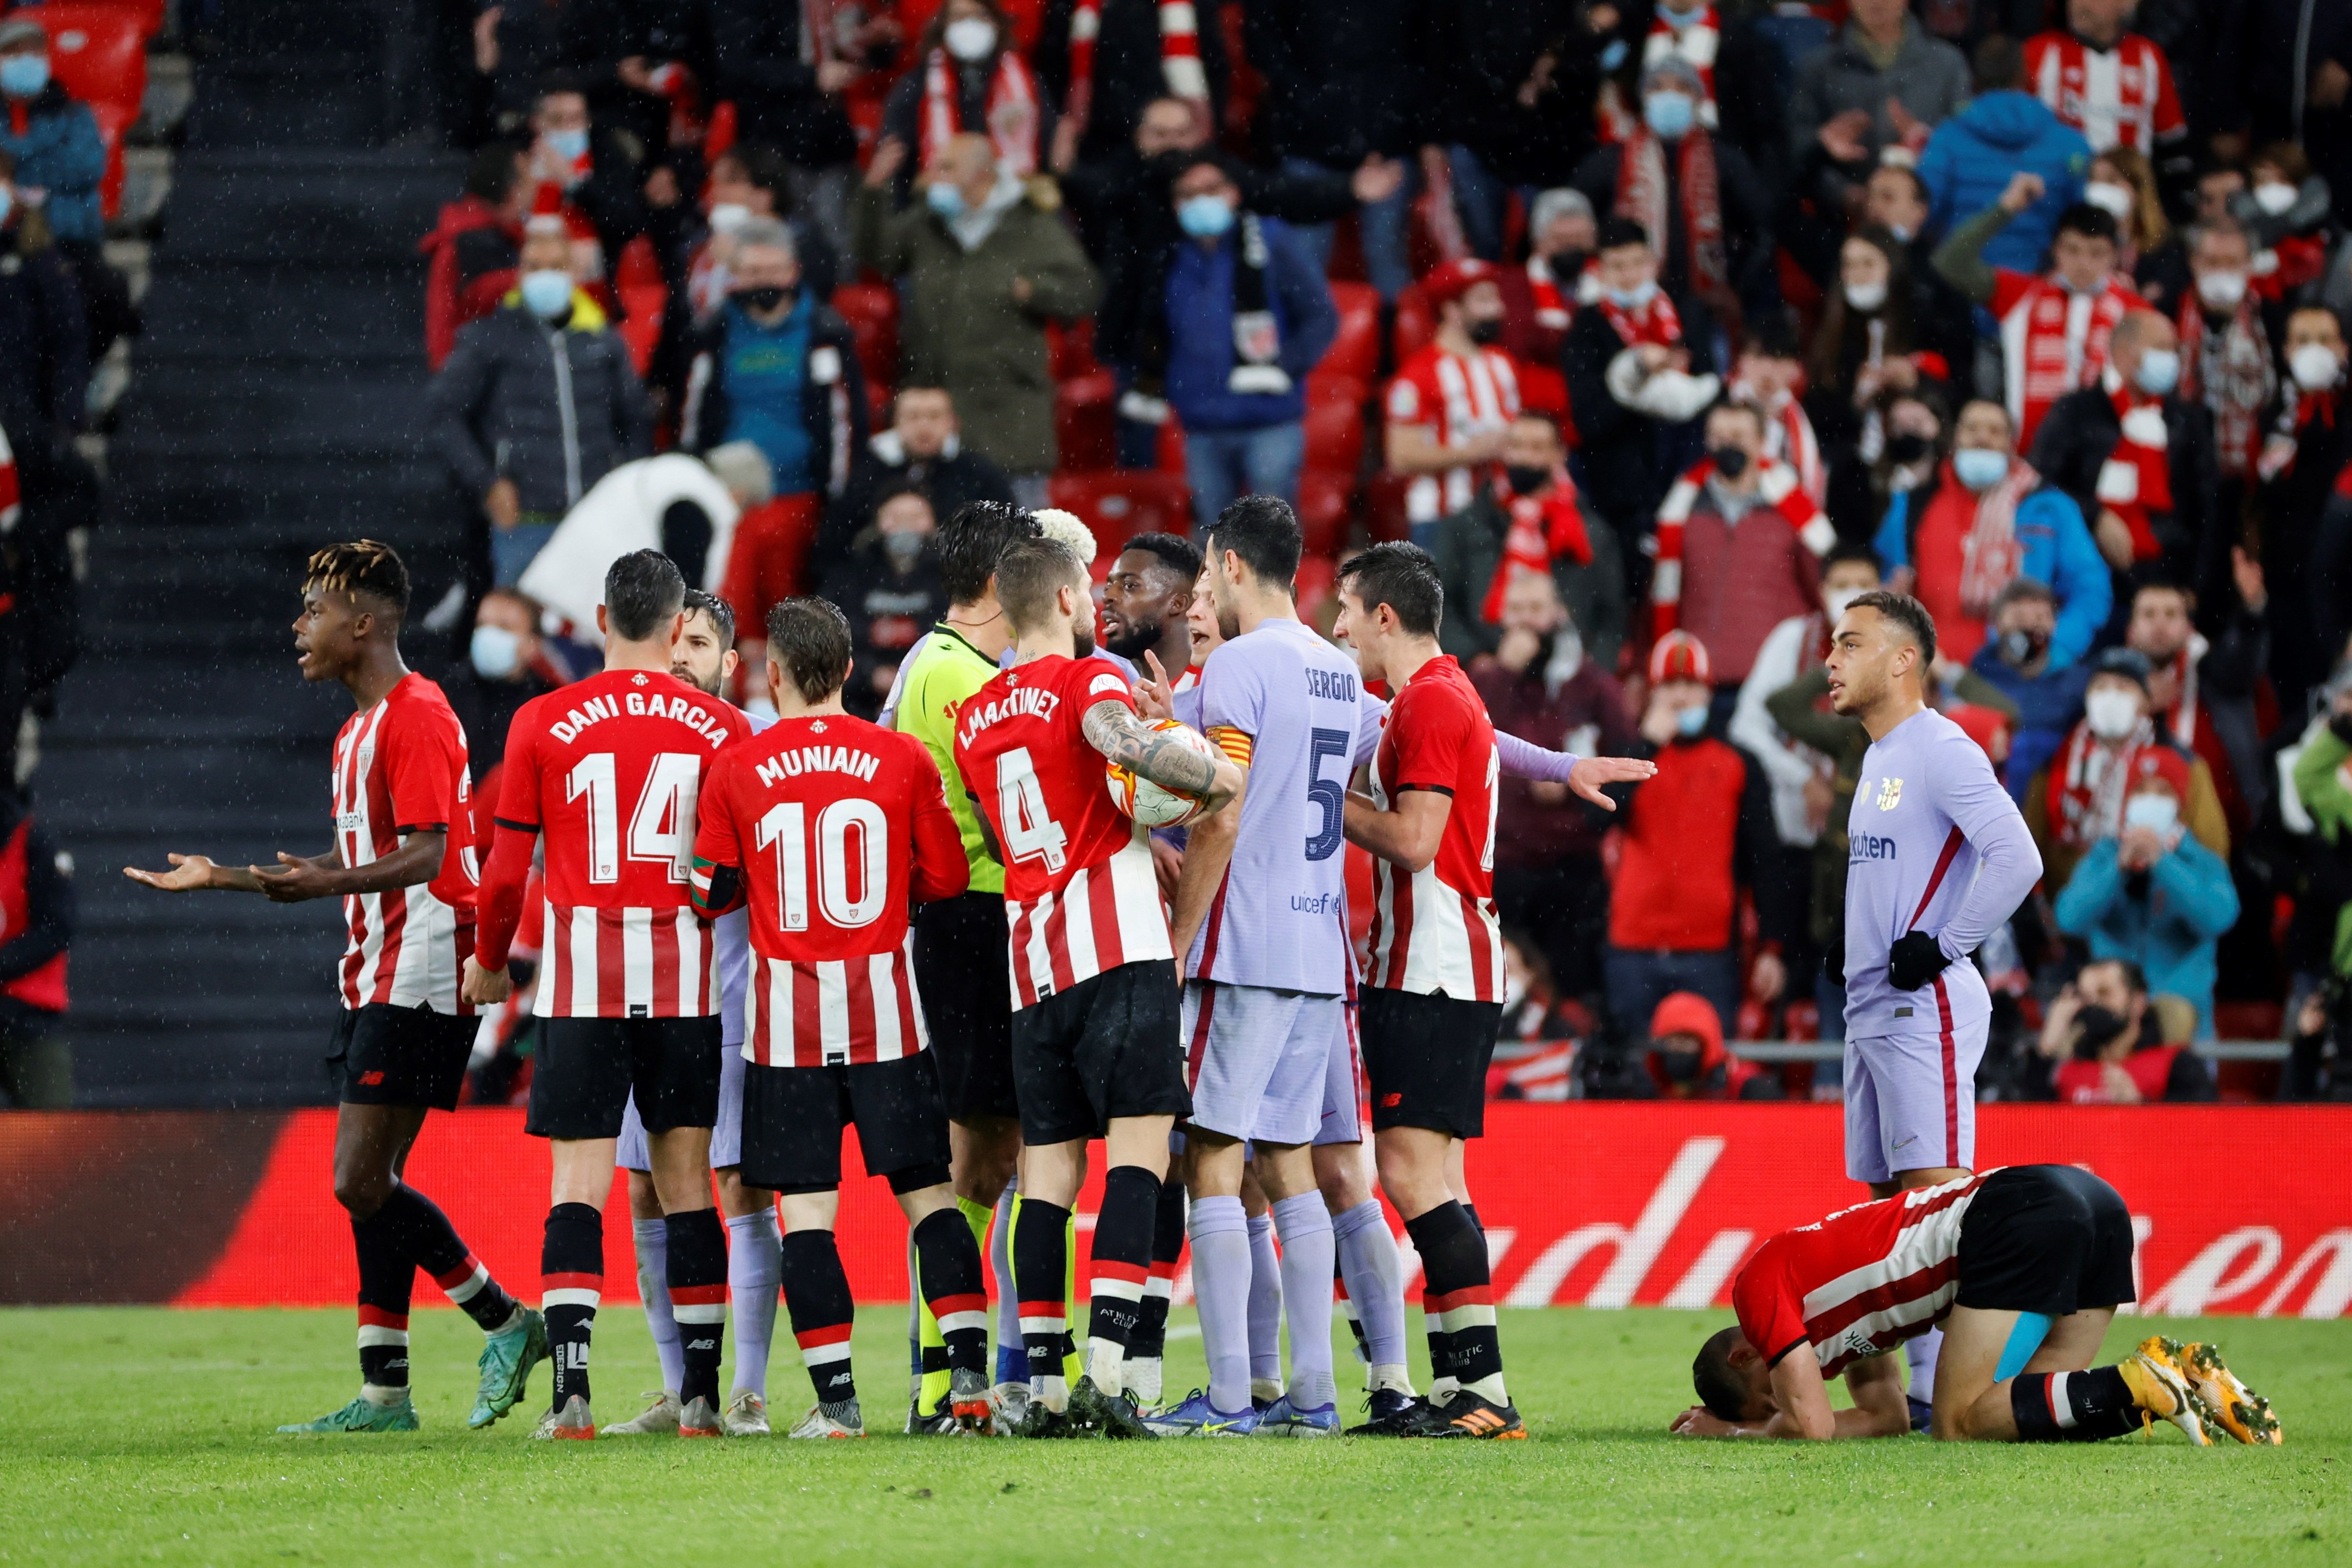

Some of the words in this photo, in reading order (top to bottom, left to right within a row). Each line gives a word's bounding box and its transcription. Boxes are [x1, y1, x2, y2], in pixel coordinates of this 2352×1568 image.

[549, 693, 619, 744] DANI
[625, 692, 728, 750] GARCIA
[1305, 667, 1356, 703] SERGIO
[566, 752, 701, 884] 14
[755, 745, 880, 788] MUNIAIN
[996, 746, 1068, 876] 4
[1305, 727, 1350, 861] 5
[755, 798, 887, 932] 10
